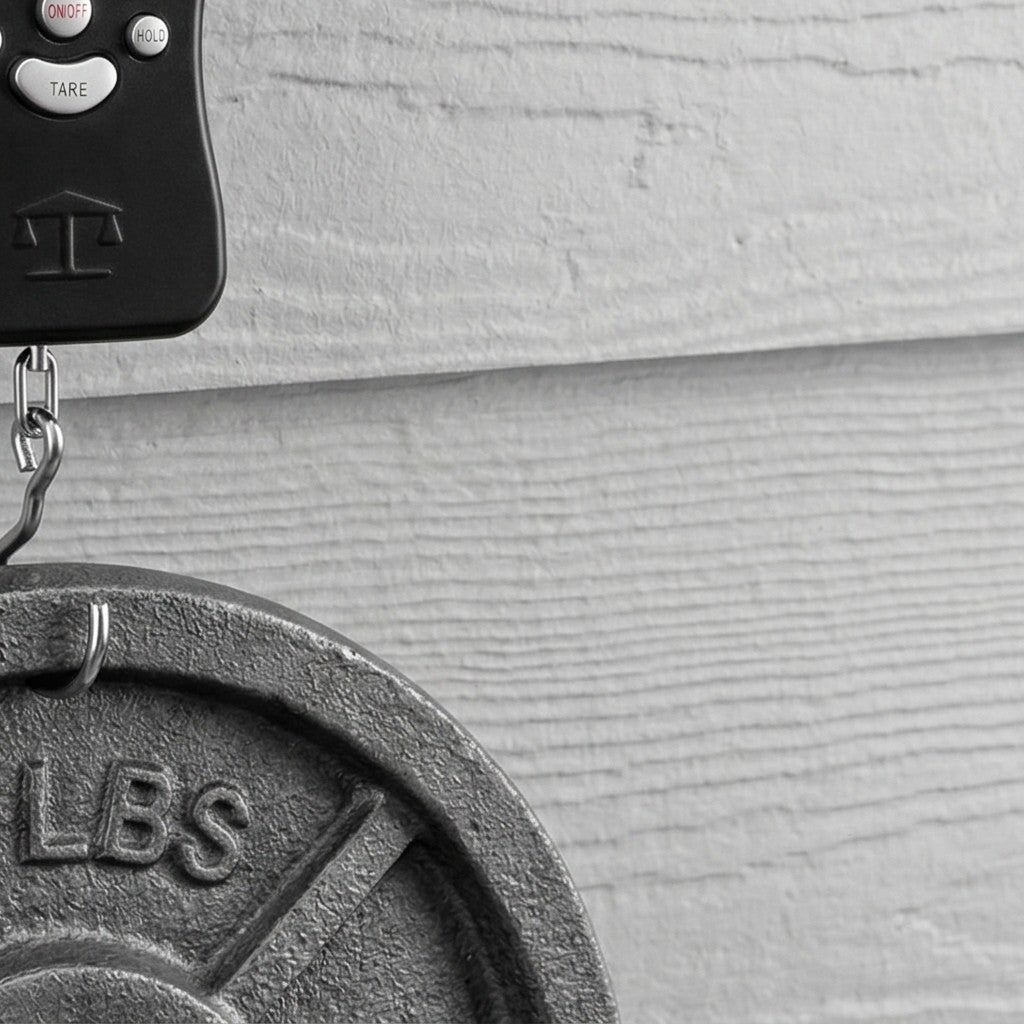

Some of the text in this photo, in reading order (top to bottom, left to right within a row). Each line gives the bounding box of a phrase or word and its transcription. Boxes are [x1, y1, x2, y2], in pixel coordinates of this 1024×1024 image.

[136, 28, 166, 43] HOLD
[49, 81, 88, 97] TARE
[18, 758, 251, 882] LBS
